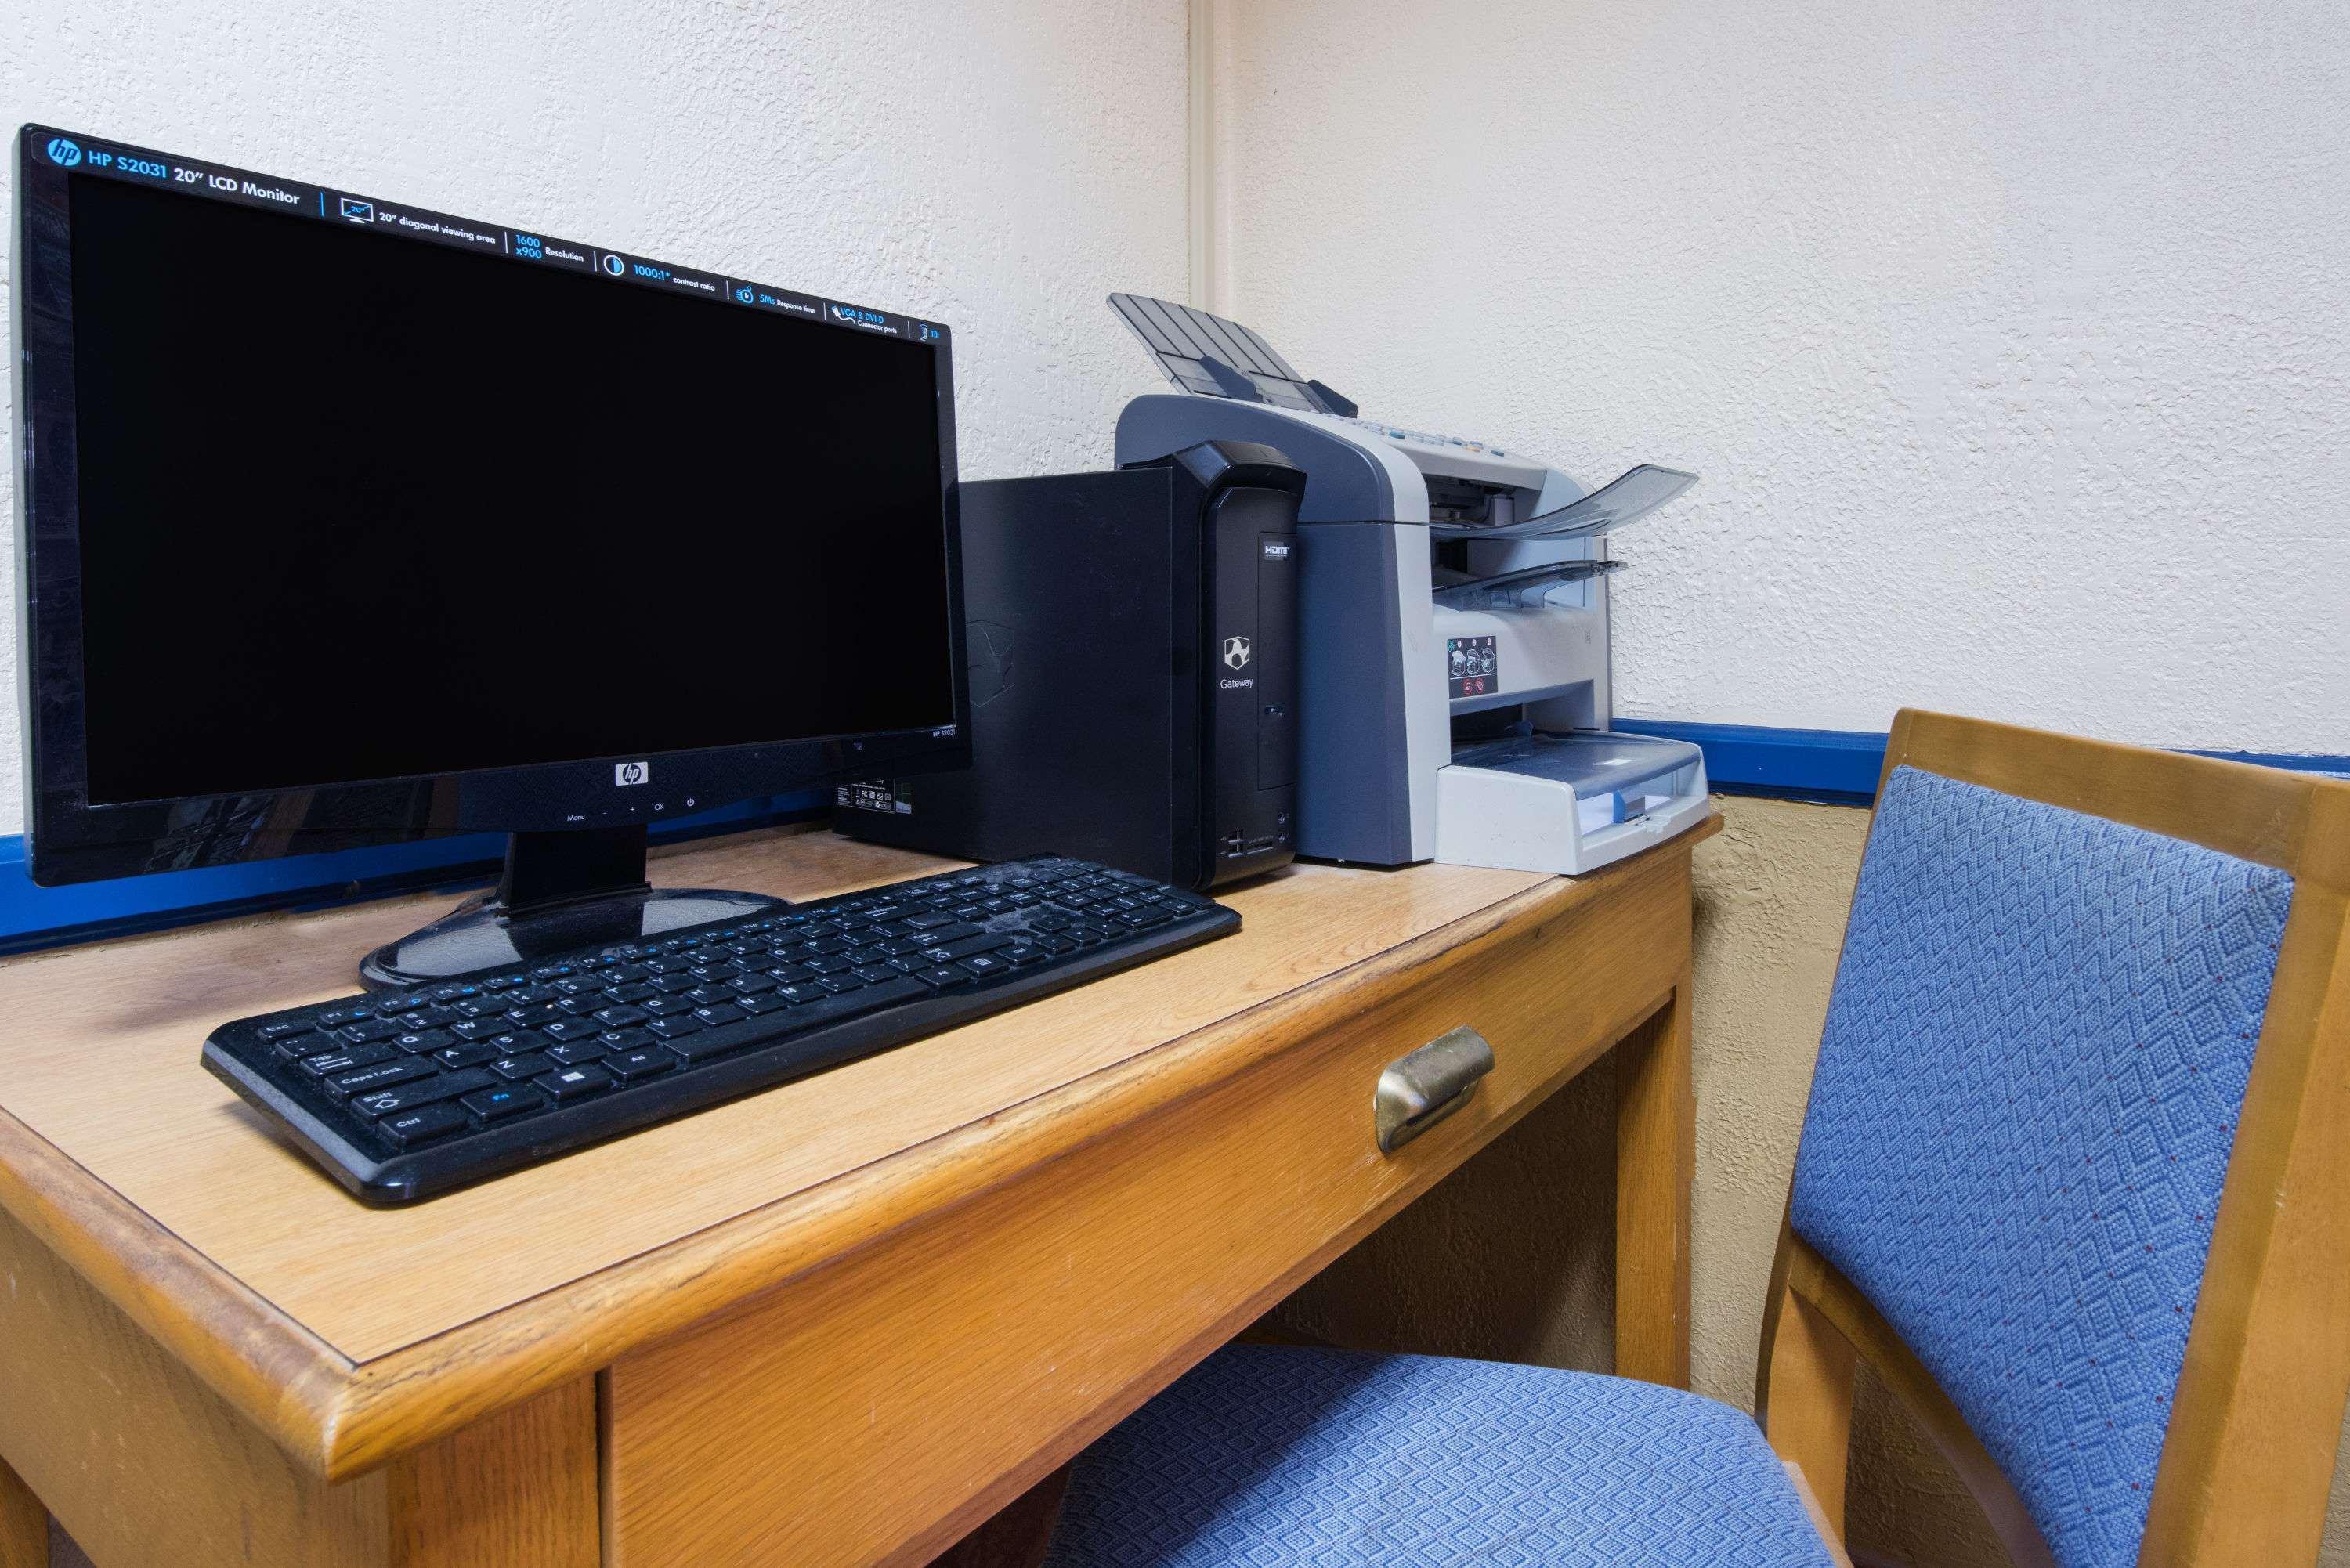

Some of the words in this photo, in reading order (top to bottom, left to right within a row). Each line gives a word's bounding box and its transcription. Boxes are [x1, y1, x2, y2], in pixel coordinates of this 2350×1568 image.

[48, 138, 81, 167] hp
[89, 150, 113, 168] HP
[118, 157, 168, 179] S2031
[209, 174, 238, 192] LCD
[242, 182, 301, 204] Monitor
[400, 215, 439, 233] diagonal
[441, 224, 475, 242] viewing
[475, 233, 496, 245] area
[515, 234, 540, 248] 1600
[515, 246, 543, 260] x900
[544, 247, 584, 262] Resolution
[673, 276, 700, 288] contrast
[700, 282, 715, 291] ratio
[759, 294, 776, 305] 5Ms
[776, 299, 803, 312] Response
[803, 305, 815, 314] time
[840, 307, 857, 319] VGA
[858, 311, 864, 320] &
[865, 313, 885, 324] DVI-D
[857, 320, 884, 331] Connector
[884, 326, 898, 334] ports
[1220, 678, 1253, 689] Gateway
[498, 1060, 515, 1068] Z
[342, 1075, 374, 1085] Caps
[374, 1067, 403, 1077] Lock
[363, 1092, 393, 1103] Shift
[396, 1117, 421, 1128] Ctrl
